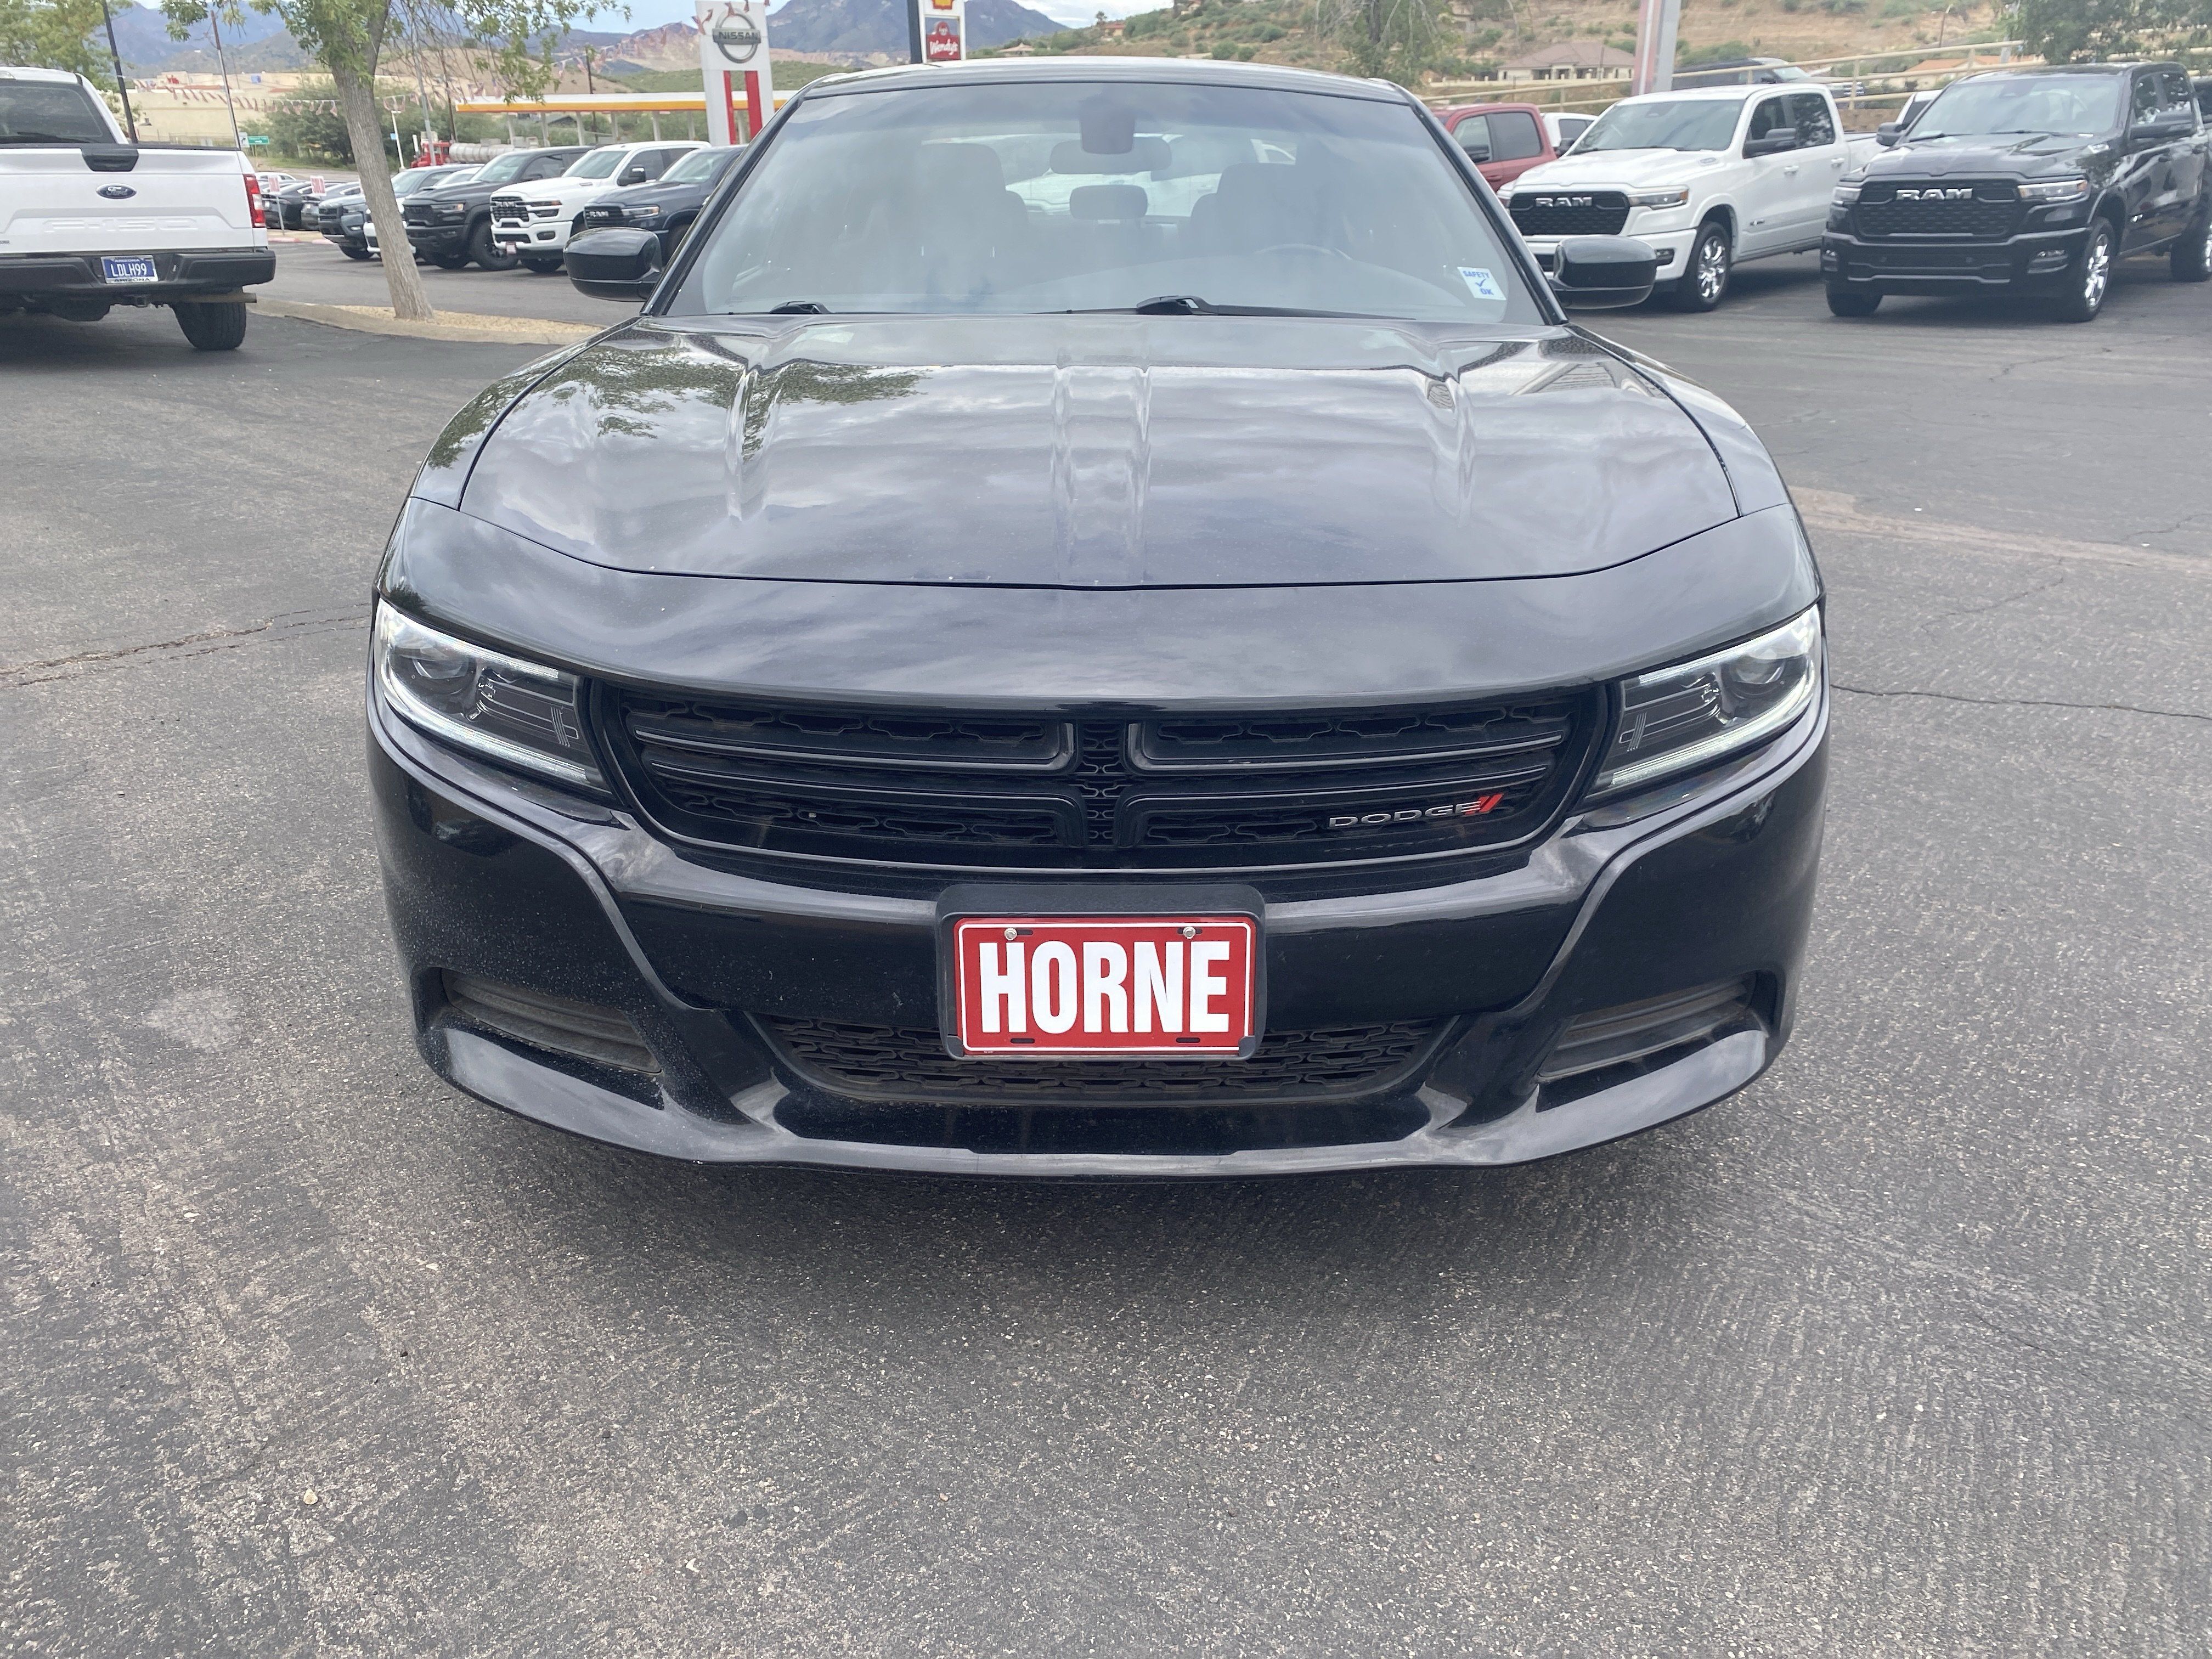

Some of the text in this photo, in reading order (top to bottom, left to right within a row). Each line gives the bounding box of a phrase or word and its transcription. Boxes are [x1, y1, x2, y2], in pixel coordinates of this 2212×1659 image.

[719, 31, 757, 40] NISSAN
[1896, 188, 1973, 200] RAM
[1536, 197, 1592, 207] RAM
[110, 263, 146, 276] LDLH99
[1329, 800, 1482, 827] DODGE
[979, 940, 1230, 1034] HORNE
